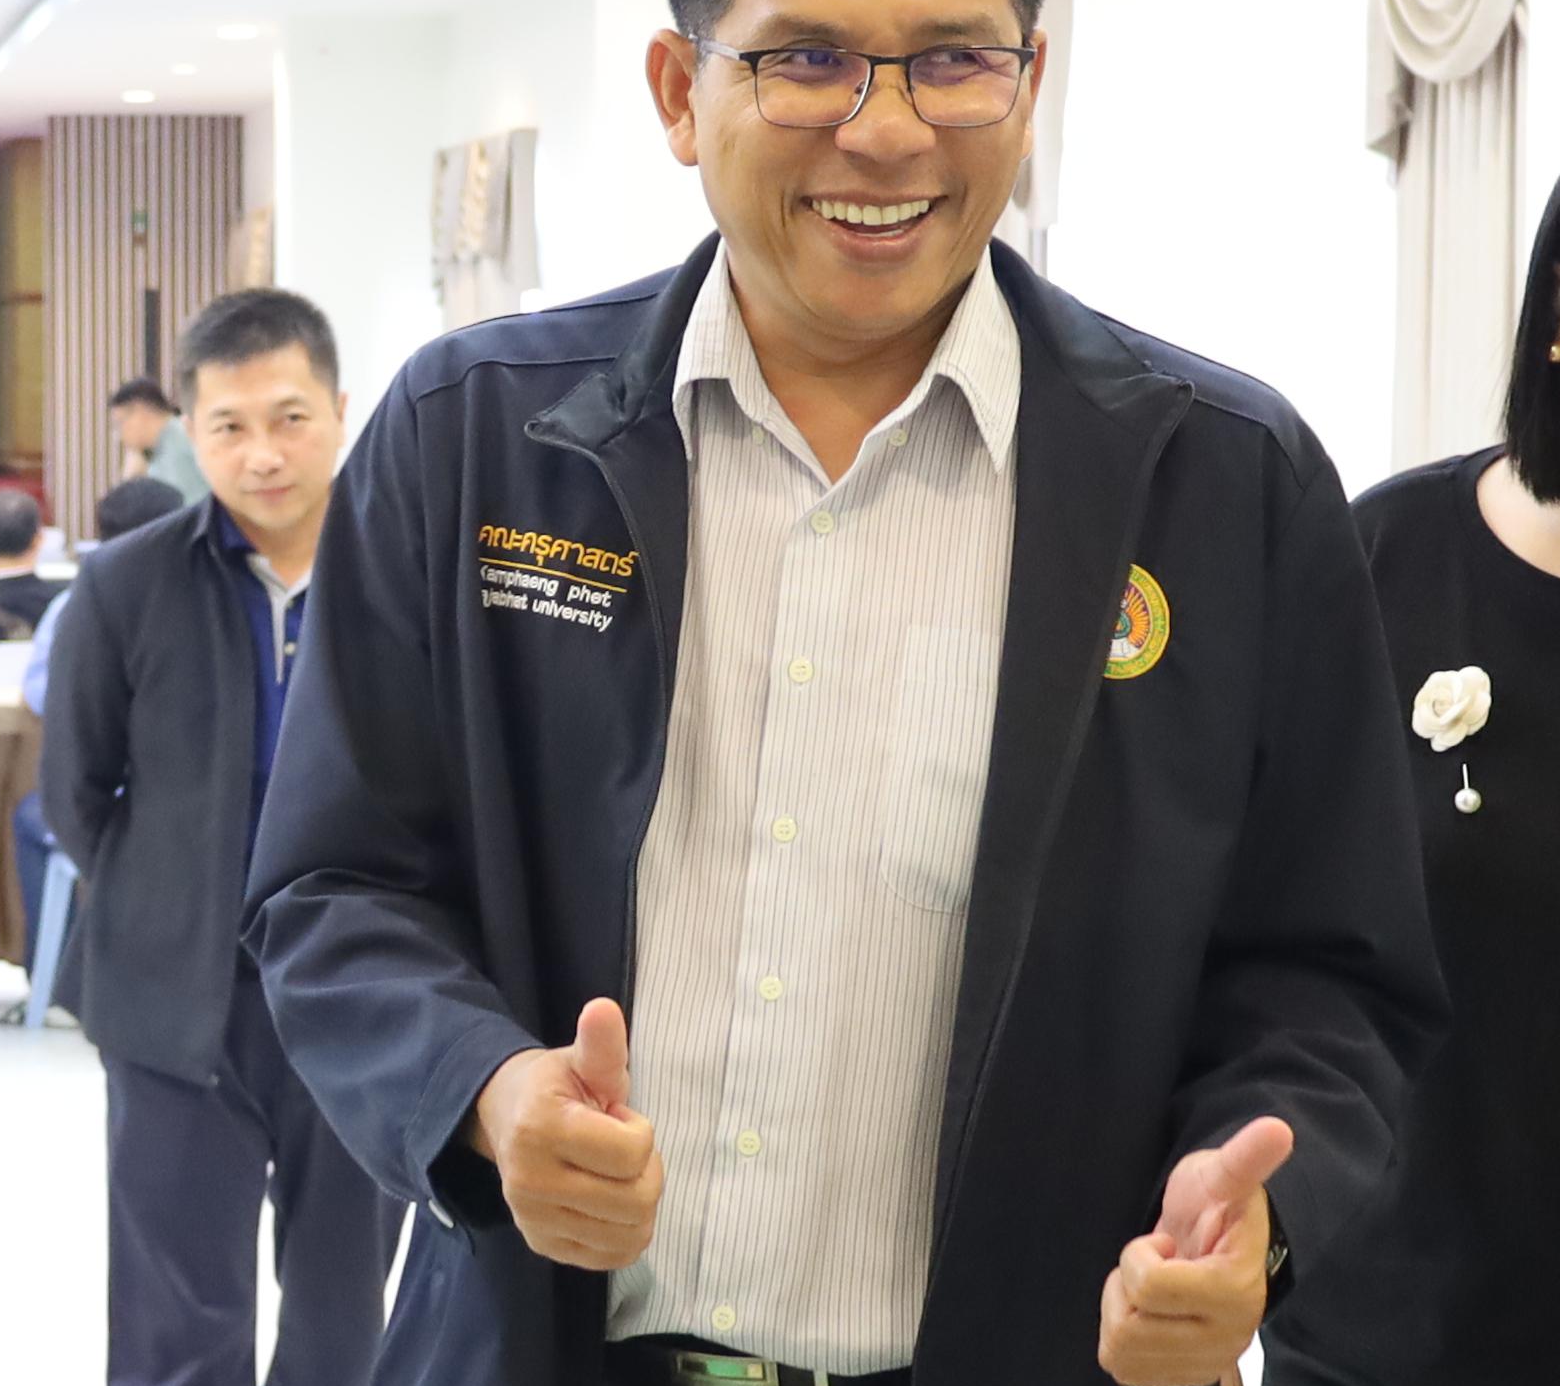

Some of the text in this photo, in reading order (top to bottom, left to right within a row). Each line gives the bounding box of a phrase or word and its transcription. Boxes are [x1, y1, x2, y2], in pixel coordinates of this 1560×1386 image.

[478, 524, 640, 577] คณะครุศาสตร์
[481, 587, 613, 632] ajabhat university
[567, 585, 612, 608] phet
